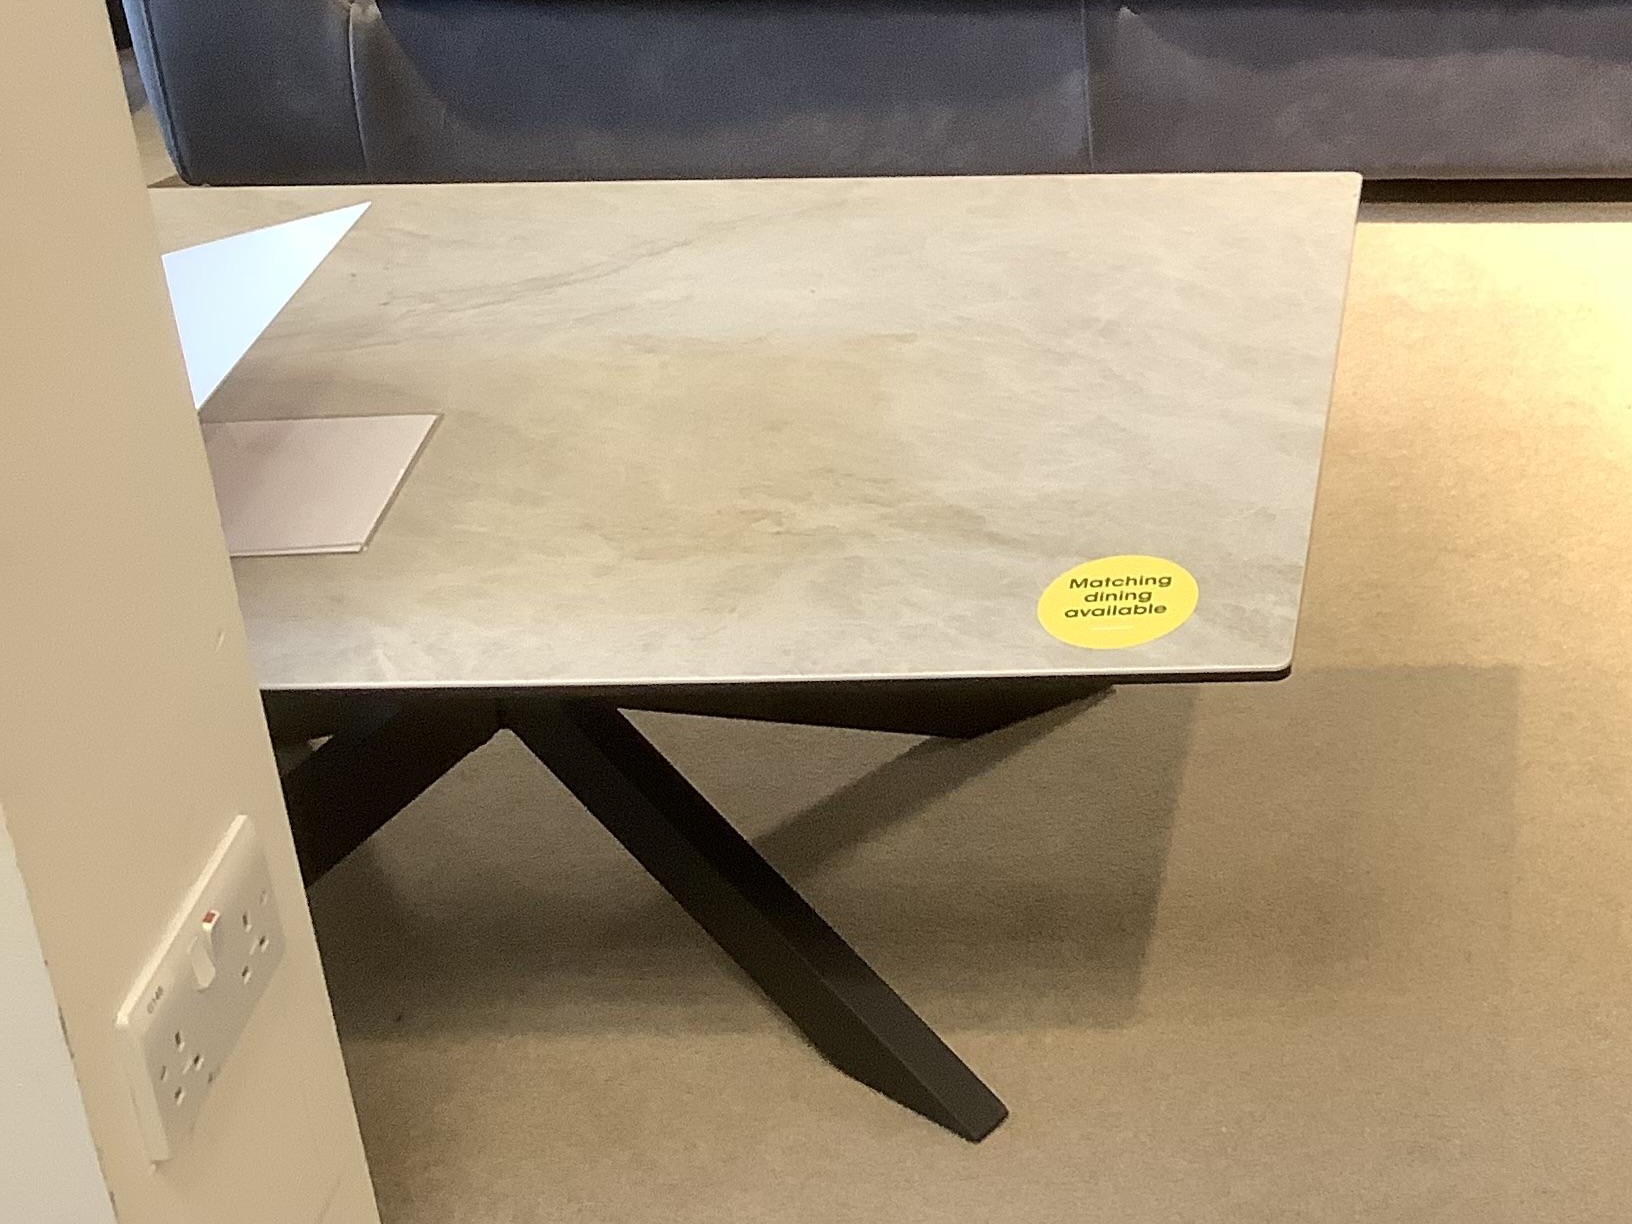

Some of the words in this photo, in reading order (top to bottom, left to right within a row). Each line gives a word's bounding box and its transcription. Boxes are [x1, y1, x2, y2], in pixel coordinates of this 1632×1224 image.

[1069, 575, 1173, 589] Matching
[1084, 590, 1153, 603] dining
[1064, 604, 1168, 618] available
